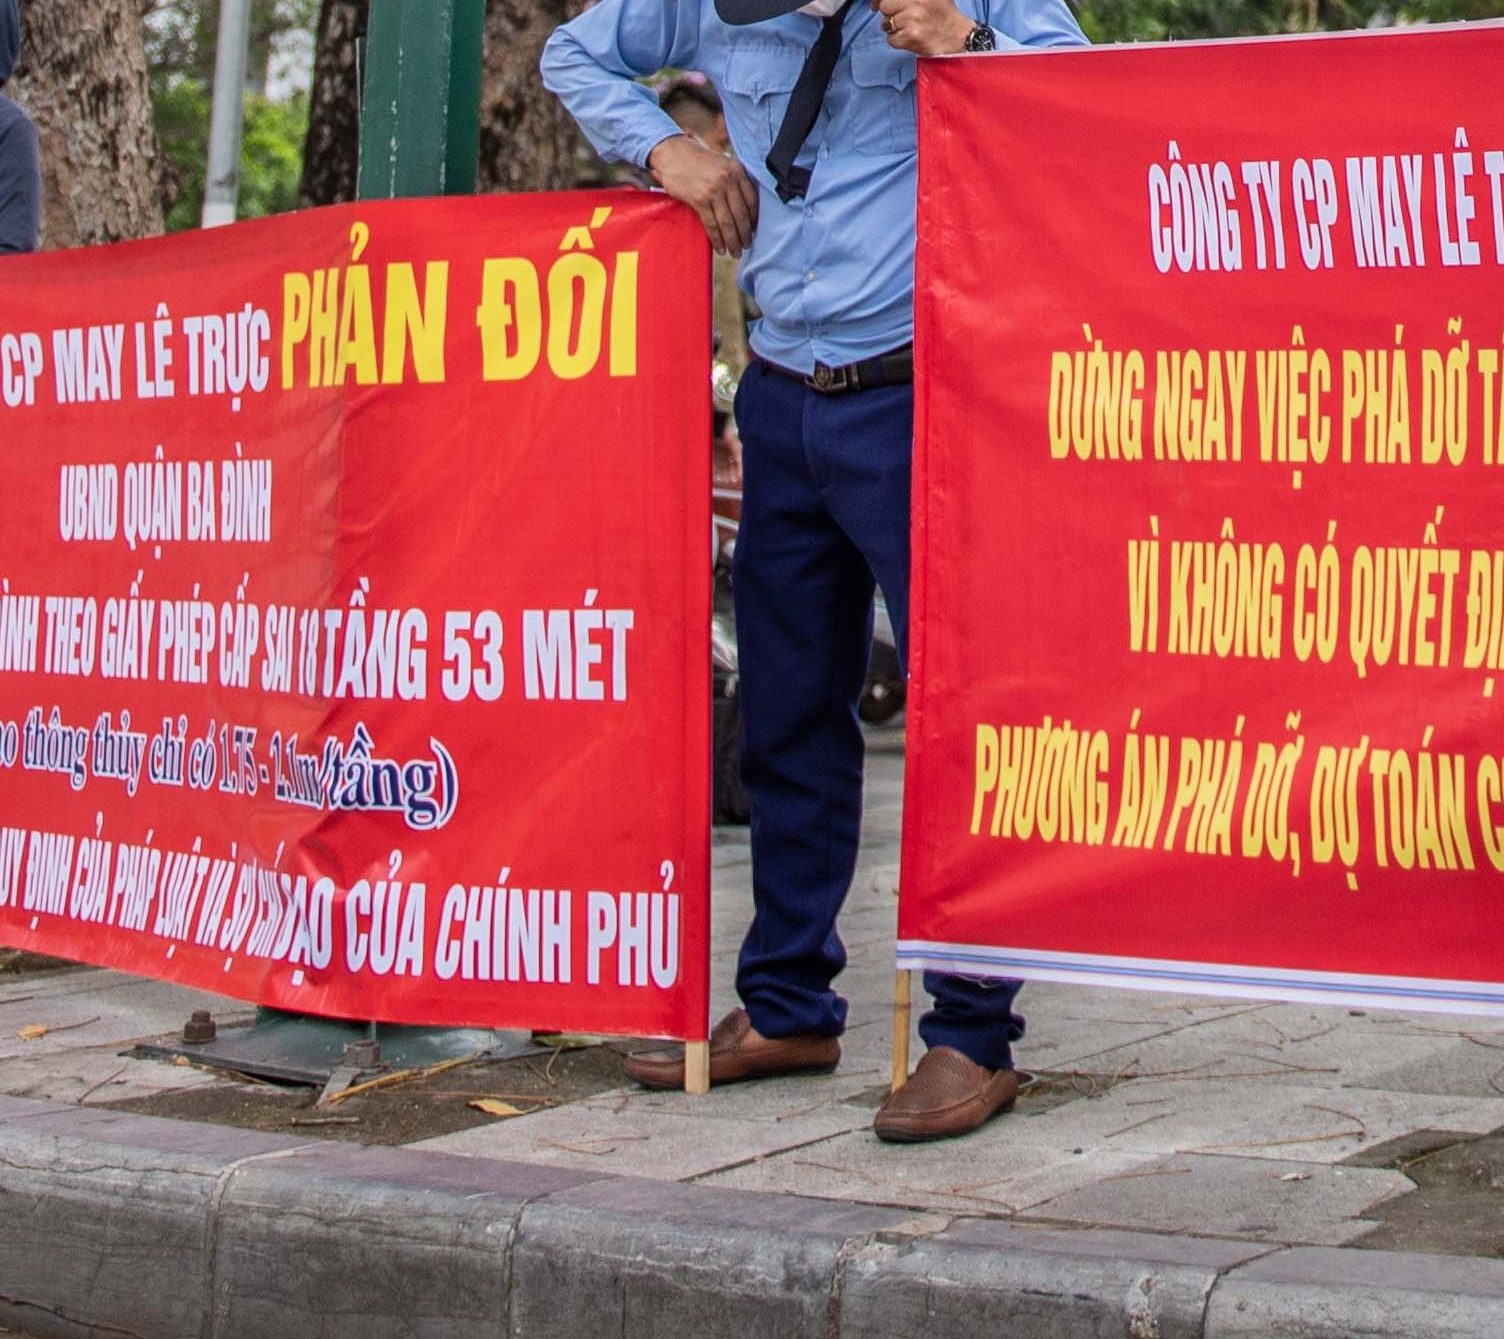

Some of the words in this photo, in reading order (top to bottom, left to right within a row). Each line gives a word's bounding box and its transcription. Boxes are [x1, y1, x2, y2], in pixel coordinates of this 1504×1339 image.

[1149, 141, 1242, 272] CÔNG
[1242, 161, 1285, 269] TY
[1293, 159, 1337, 269] CP
[1346, 155, 1425, 267] MAY
[1434, 127, 1480, 265] LÊ
[1, 333, 43, 406] CP
[53, 324, 124, 403] MAY
[136, 303, 174, 398] LÊ
[183, 303, 270, 411] TRỰC
[282, 222, 448, 389] PHẢN
[477, 207, 638, 380] ĐỐI
[1049, 324, 1144, 460] DỪNG
[1154, 350, 1246, 461] NGAY
[1256, 326, 1330, 488] VIỆC
[1343, 325, 1410, 463] PHÁ
[1422, 317, 1469, 465] DỠ
[60, 464, 118, 540] UBND
[124, 445, 181, 559] QUẬN
[188, 461, 215, 541] BA
[221, 443, 272, 541] ĐÌNH
[45, 597, 97, 676] THEO
[101, 570, 154, 679] GIẤY
[158, 584, 215, 683] PHÉP
[220, 573, 259, 687] CẤP
[262, 604, 295, 692] SAI
[299, 609, 319, 696] 18
[323, 577, 427, 700] TẦNG
[442, 610, 504, 701] 53
[523, 589, 634, 700] MÉT
[1128, 516, 1159, 652] VÌ
[1168, 518, 1284, 659] KHÔNG
[1294, 521, 1339, 662] CÓ
[1350, 506, 1460, 677] QUYẾT
[23, 706, 89, 790] thông
[93, 710, 147, 796] thủy
[149, 715, 187, 785] chỉ
[189, 720, 216, 790] có
[219, 723, 257, 795] 1.75
[971, 716, 1108, 845] PHƯƠNG
[1112, 709, 1169, 848] ÁN
[1164, 715, 1245, 855] PHÁ
[1242, 712, 1304, 875] DỠ,
[1311, 736, 1369, 889] DỰ
[1370, 726, 1474, 869] TOÁN
[24, 831, 74, 929] ĐỊNH
[71, 812, 111, 922] CỦA
[108, 830, 161, 930] PHÁP
[154, 837, 210, 958] LUẬT
[193, 837, 236, 946] VÀ
[346, 850, 425, 976] CỦA
[436, 867, 571, 982] CHÍNH
[588, 861, 678, 987] PHỦ
